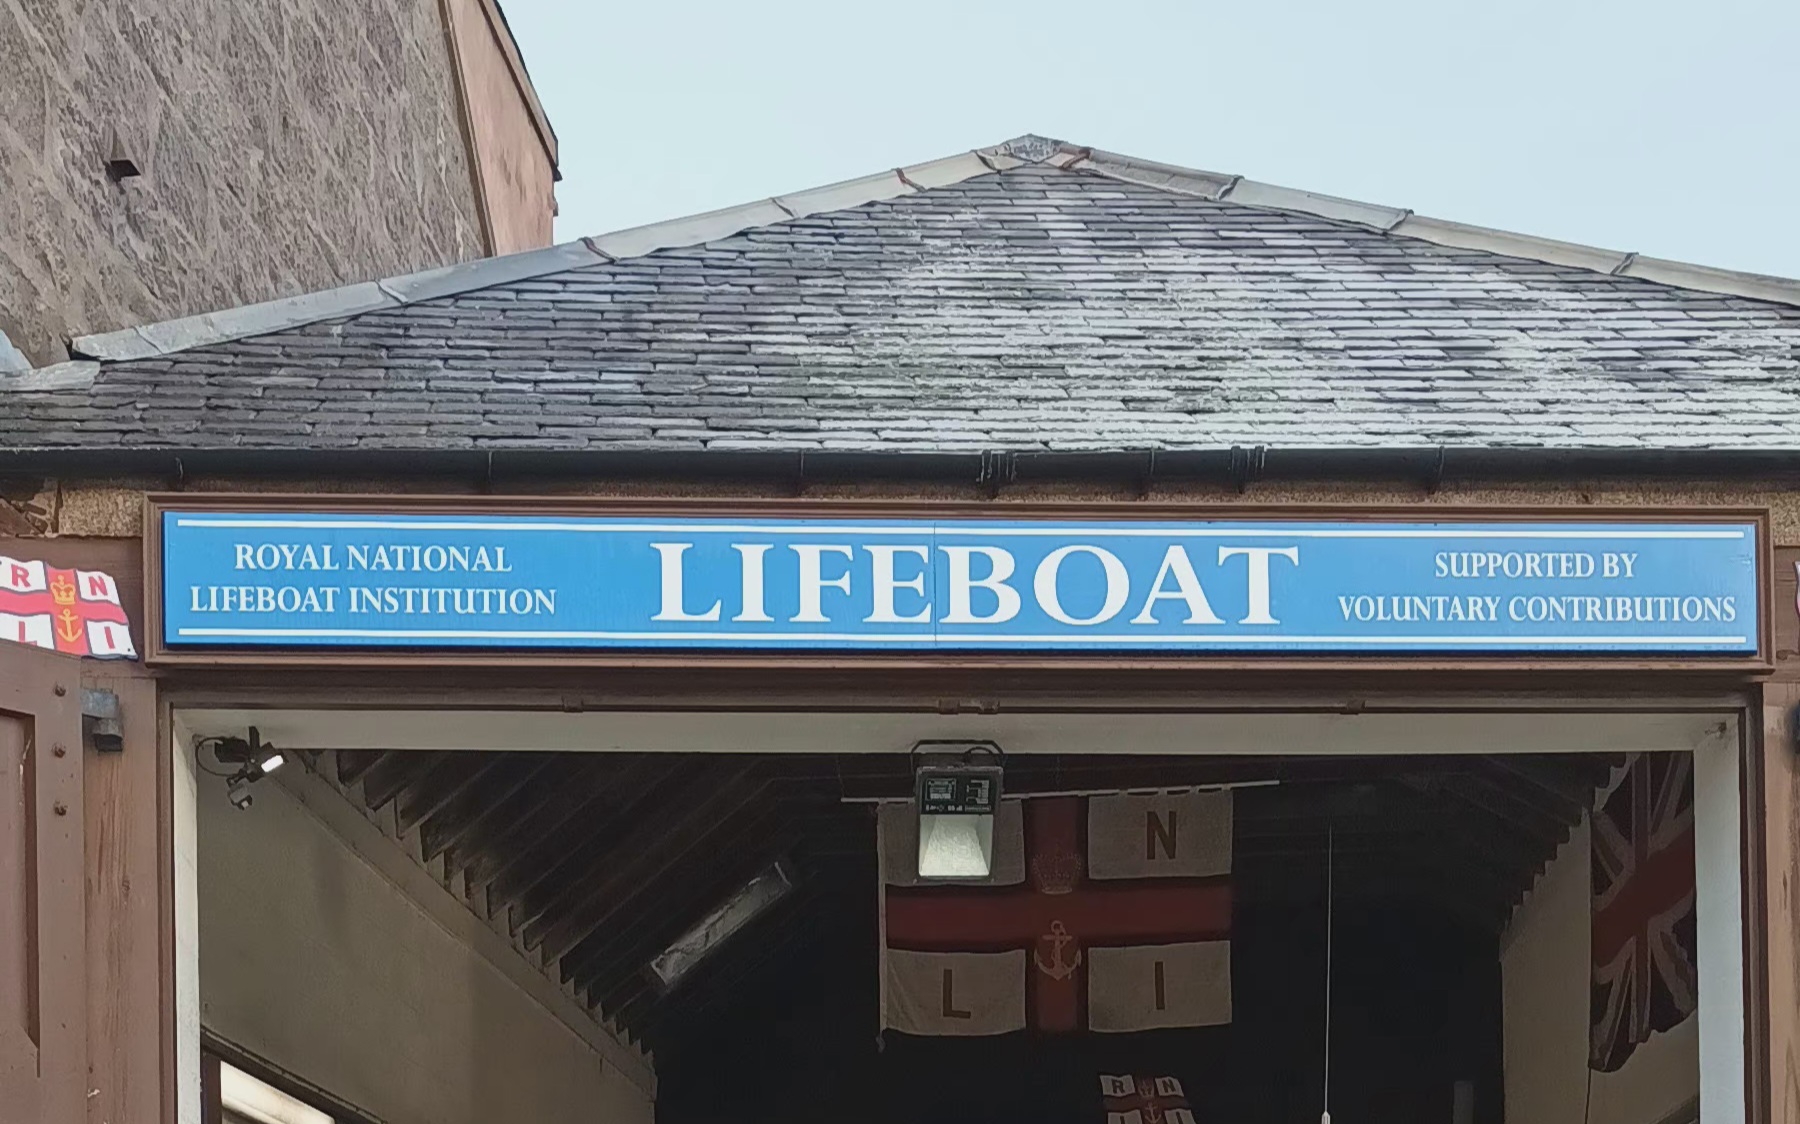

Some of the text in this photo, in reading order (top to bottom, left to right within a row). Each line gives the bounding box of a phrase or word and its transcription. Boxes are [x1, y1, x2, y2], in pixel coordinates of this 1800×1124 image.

[235, 545, 512, 572] ROYAL NATIONAL
[1435, 552, 1638, 578] SUPPORTED BY
[10, 563, 108, 596] R N
[649, 542, 1299, 626] LIFEBOAT
[191, 586, 557, 615] LIFEBOAT INSTITUTION
[1338, 595, 1736, 622] VOLUNTARY CONTRIBUTIONS
[1146, 810, 1177, 860] N
[942, 968, 972, 1019] L
